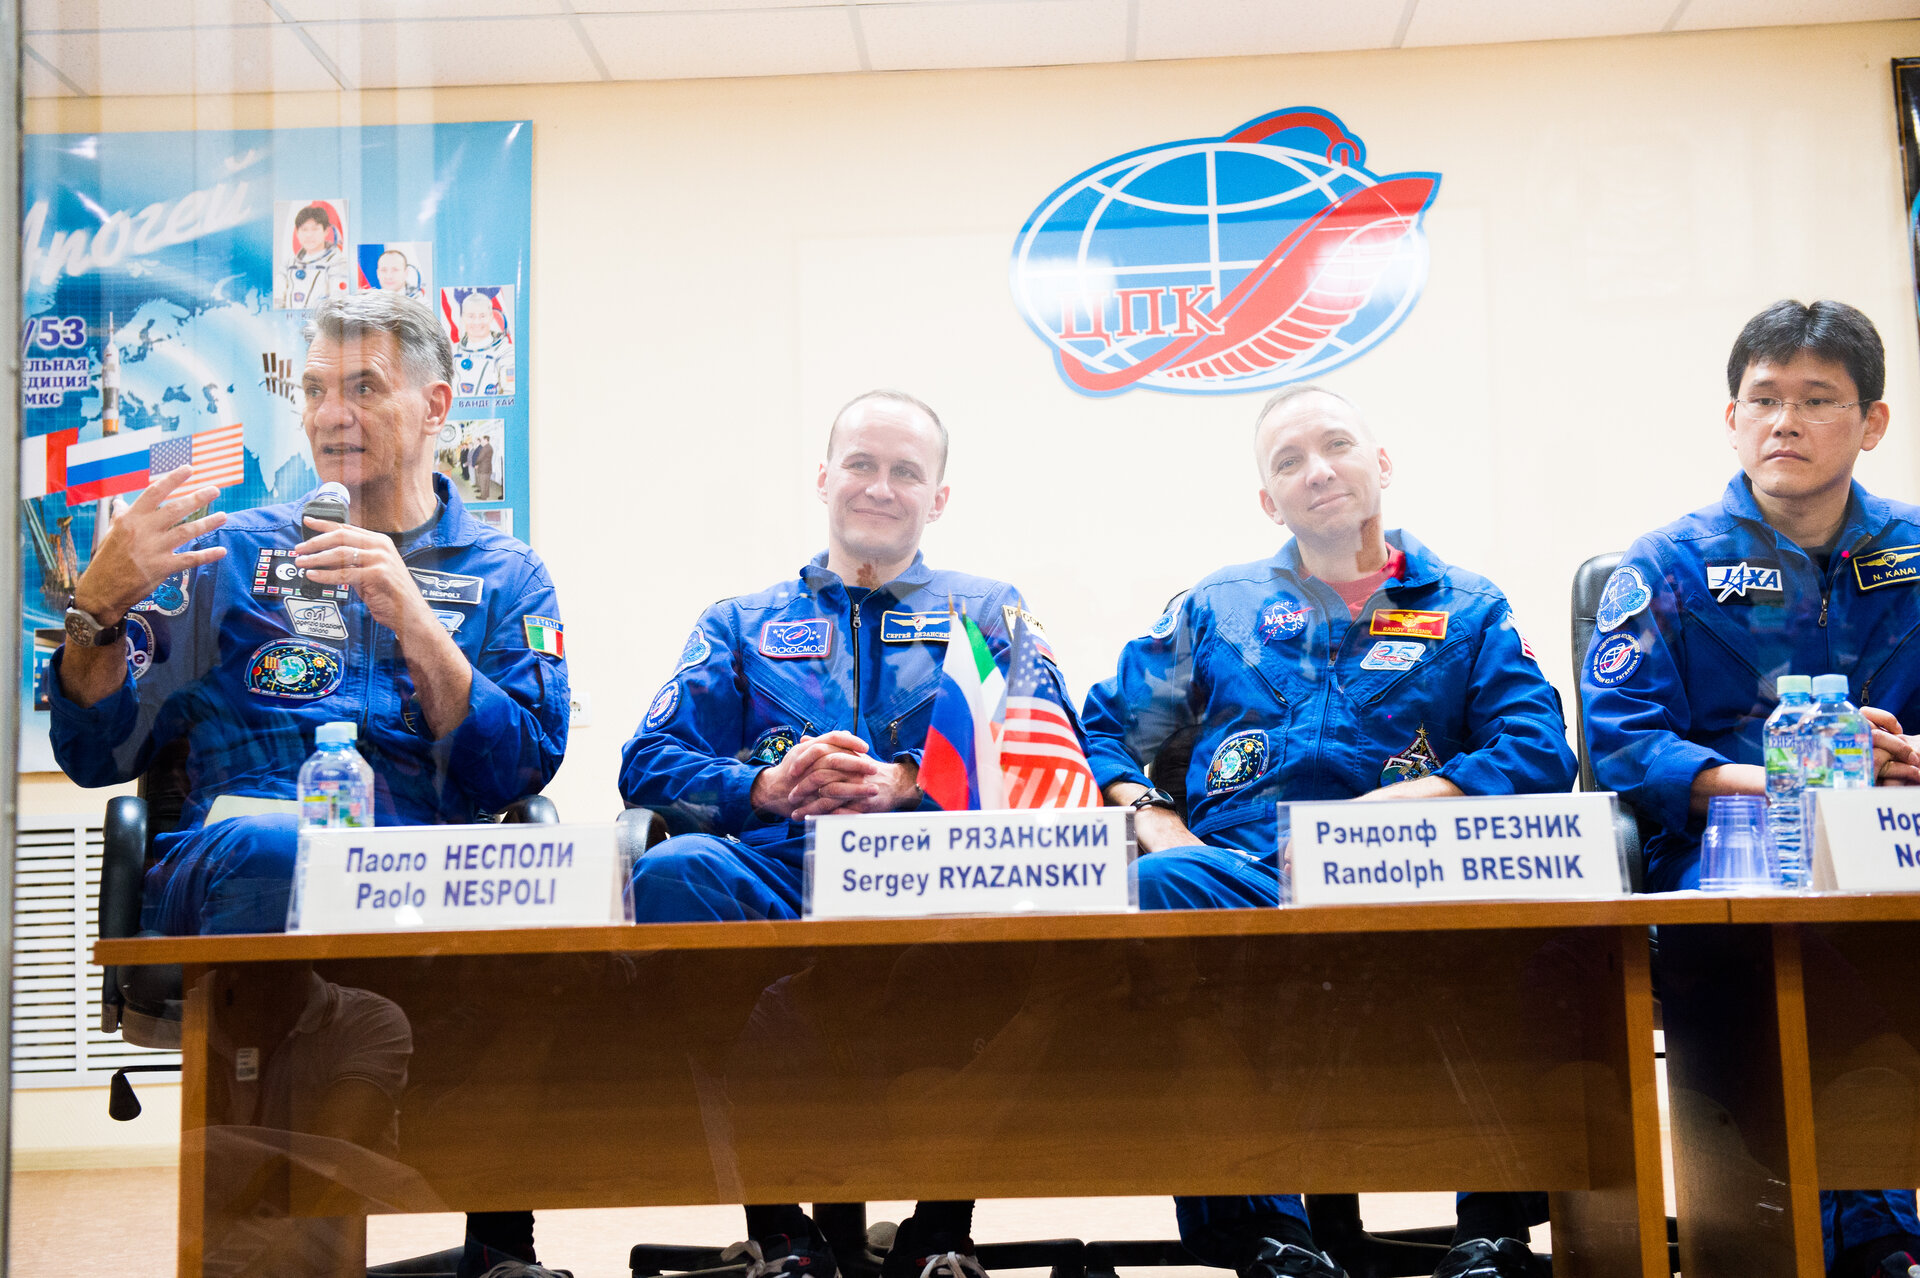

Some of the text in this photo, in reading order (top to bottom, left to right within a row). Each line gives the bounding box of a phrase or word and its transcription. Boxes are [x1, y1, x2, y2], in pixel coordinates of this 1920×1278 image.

[1058, 284, 1225, 348] ЦПК
[24, 359, 87, 372] ЛЬНАЯ
[24, 376, 88, 390] ДИЦИЯ
[24, 393, 61, 405] МКС
[1713, 565, 1779, 594] JAXA
[1885, 567, 1917, 578] KANAI
[429, 590, 462, 599] NESPOLI
[535, 618, 560, 630] ITALIA
[1264, 613, 1305, 626] NASA
[764, 644, 825, 654] РОСКОСМОС
[841, 818, 1108, 858] Сергей РЯЗАНСКИЙ
[1316, 814, 1582, 847] Рэндолф БРЕЗНИК
[346, 842, 574, 873] Паоло НЕСПОЛИ
[842, 863, 1107, 897] Sergey RYAZANSKIY
[1323, 855, 1584, 888] Randolph BRESNIK
[356, 878, 556, 909] Paolo NESPOLI
